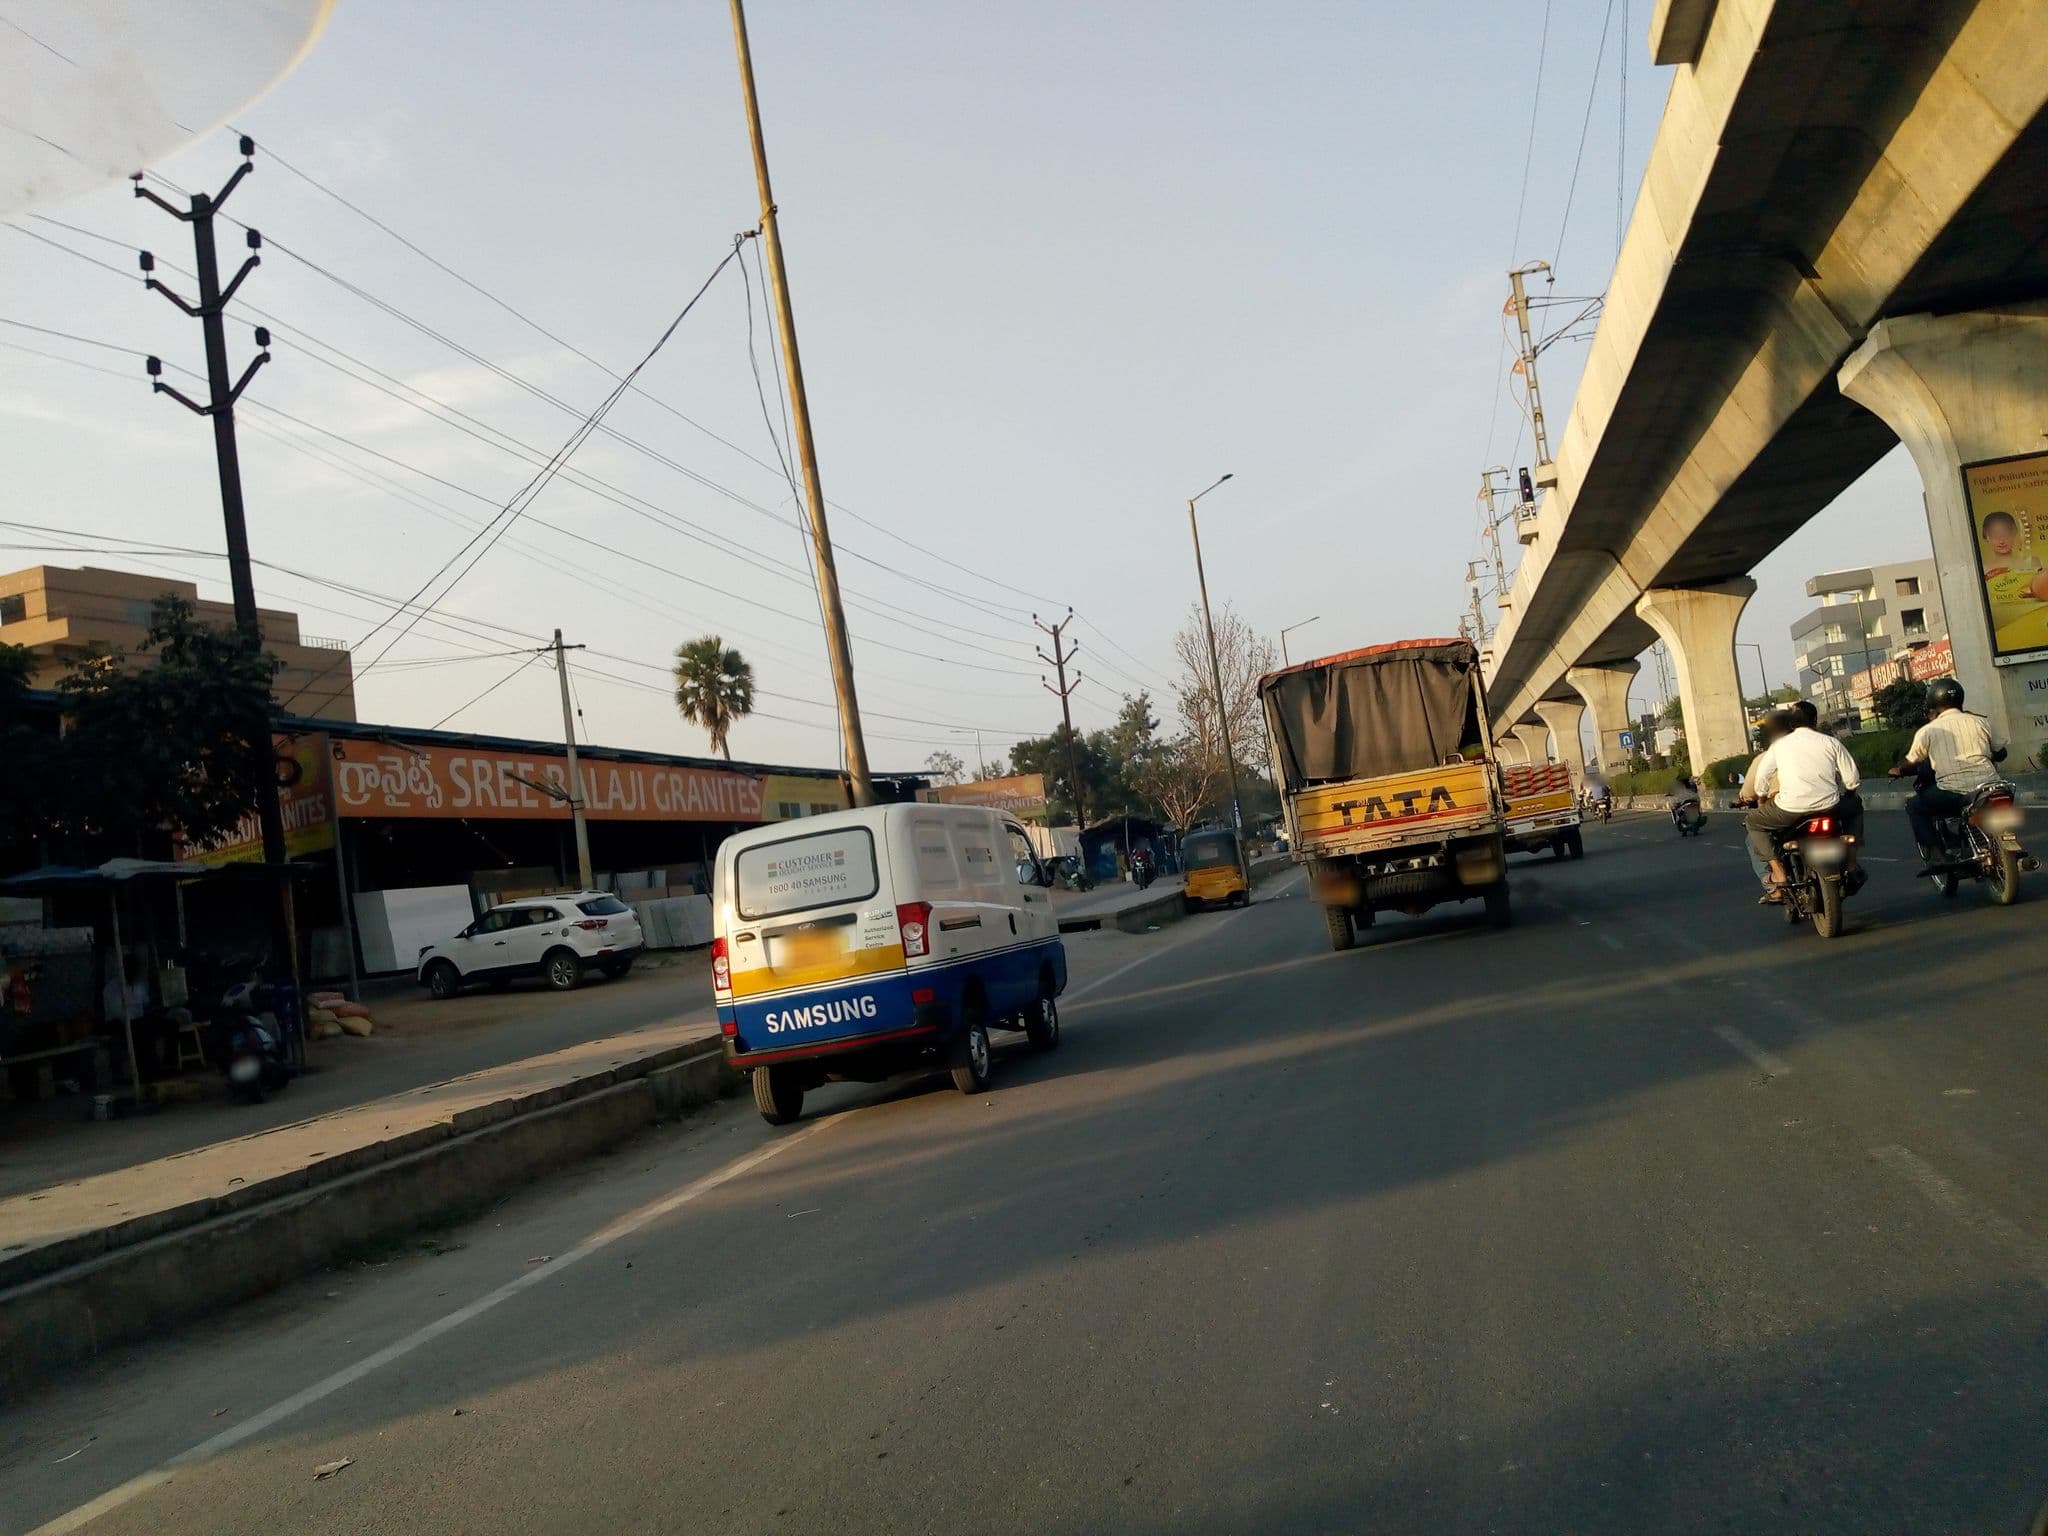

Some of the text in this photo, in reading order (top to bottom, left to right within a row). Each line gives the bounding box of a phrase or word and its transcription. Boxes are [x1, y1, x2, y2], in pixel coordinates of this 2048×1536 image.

[449, 757, 540, 809] SREE
[652, 771, 762, 816] GRANITES
[1331, 785, 1457, 826] TATA
[778, 852, 833, 870] CUSTOMER
[769, 882, 789, 895] 1800
[803, 872, 847, 889] SAMSUNG
[765, 995, 877, 1034] SAMSUNG
